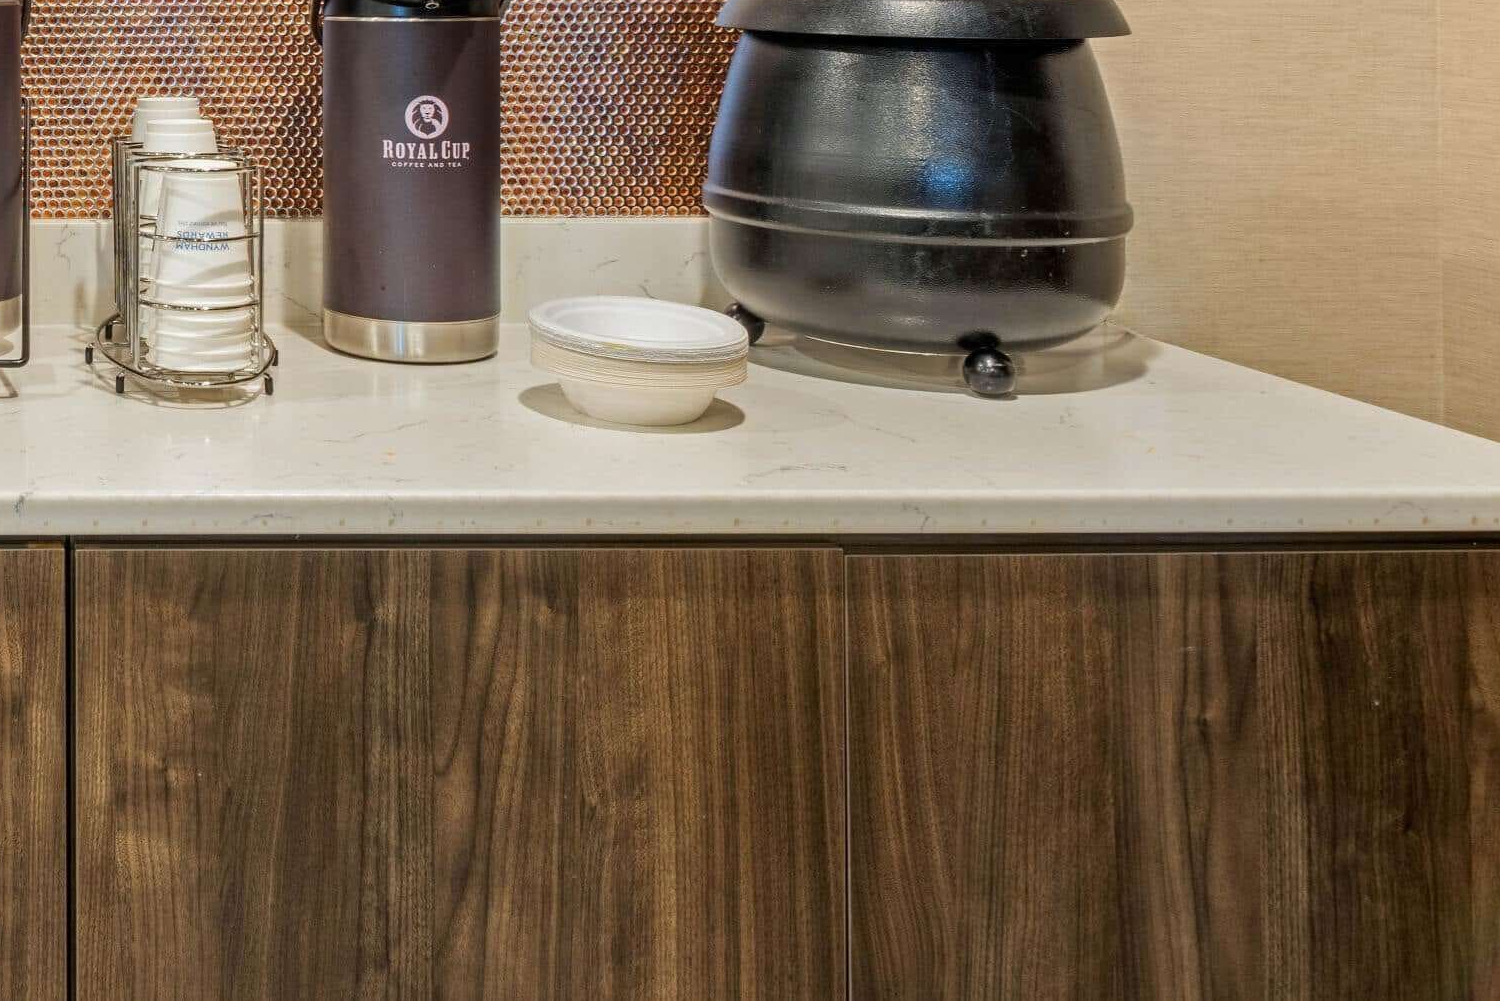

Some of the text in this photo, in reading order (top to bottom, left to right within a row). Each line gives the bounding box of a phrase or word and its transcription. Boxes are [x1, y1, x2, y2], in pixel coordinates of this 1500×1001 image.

[382, 139, 470, 160] ROYAL CUP
[176, 230, 229, 239] REWARDS
[175, 242, 230, 252] WYNDHAM
